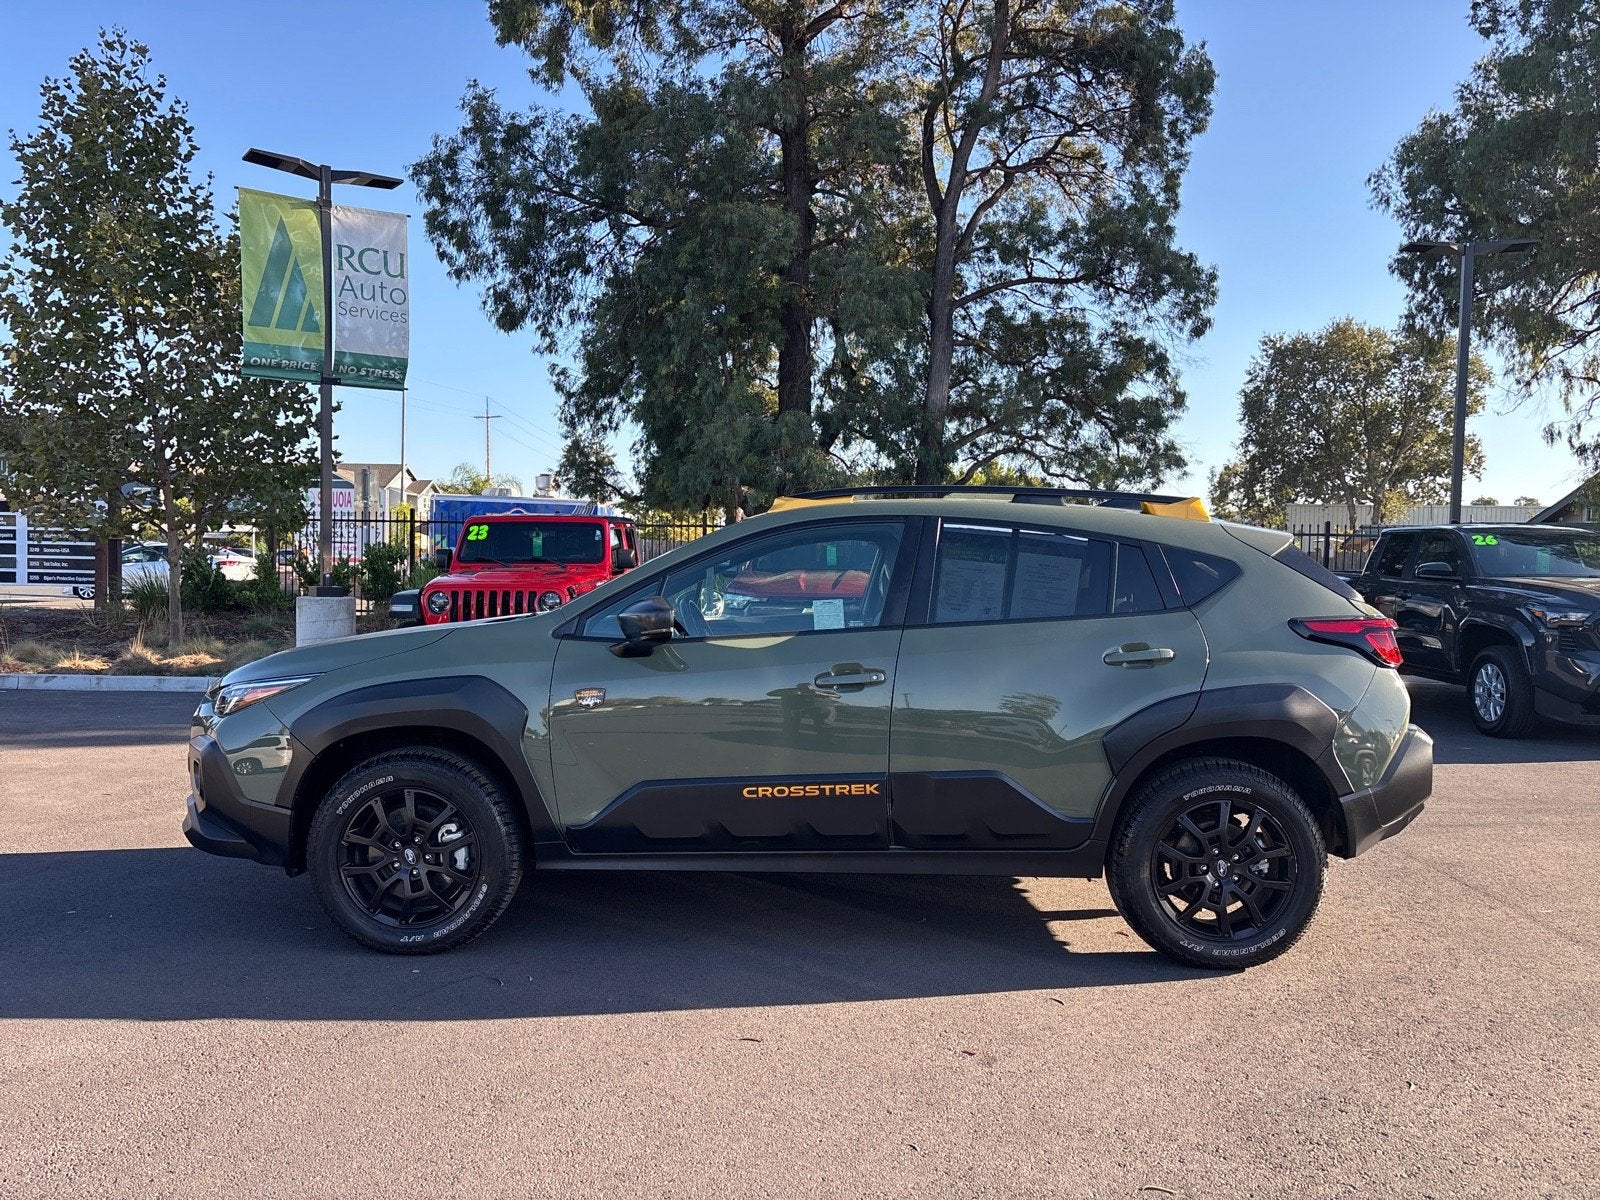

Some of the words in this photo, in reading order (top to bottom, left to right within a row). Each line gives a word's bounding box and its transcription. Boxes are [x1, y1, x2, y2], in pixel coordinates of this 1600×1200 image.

[336, 243, 405, 280] RCU
[338, 275, 406, 305] Auto
[338, 301, 407, 324] Services
[250, 356, 278, 367] ONE
[281, 359, 318, 371] PRICE
[338, 364, 357, 374] NO
[359, 367, 401, 379] STRESS
[317, 491, 352, 508] SUOIA
[467, 524, 489, 541] 23
[1471, 534, 1499, 546] 26
[336, 775, 394, 815] YOKOHAMA
[742, 783, 880, 798] CROSSTREK
[1183, 785, 1252, 801] YOKOHAMA
[400, 934, 425, 942] A/T
[1180, 939, 1206, 951] A/T
[1212, 928, 1286, 956] GEOLANDAR
